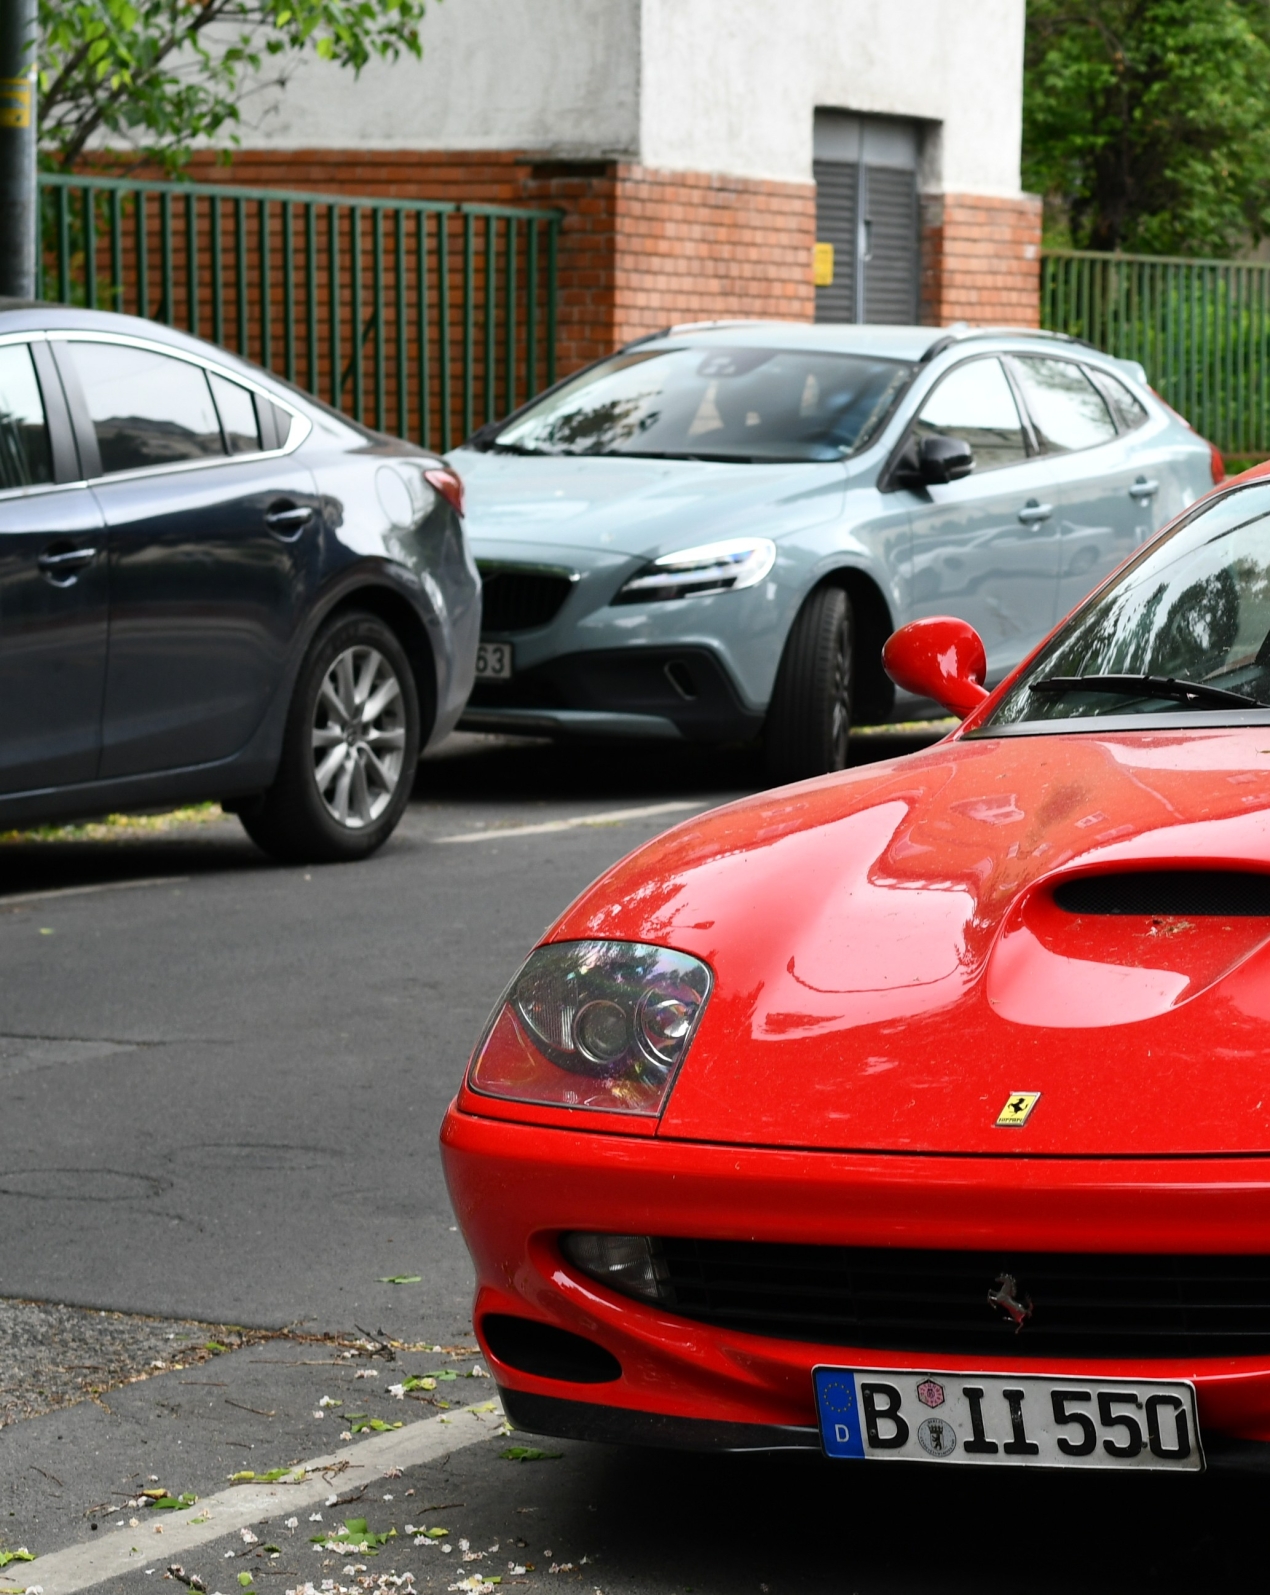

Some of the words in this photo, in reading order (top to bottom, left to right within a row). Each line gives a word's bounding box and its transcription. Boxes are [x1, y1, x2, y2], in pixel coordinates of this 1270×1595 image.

[834, 1423, 850, 1443] D
[860, 1382, 910, 1449] B
[962, 1386, 1040, 1455] II
[1050, 1389, 1192, 1459] 550
